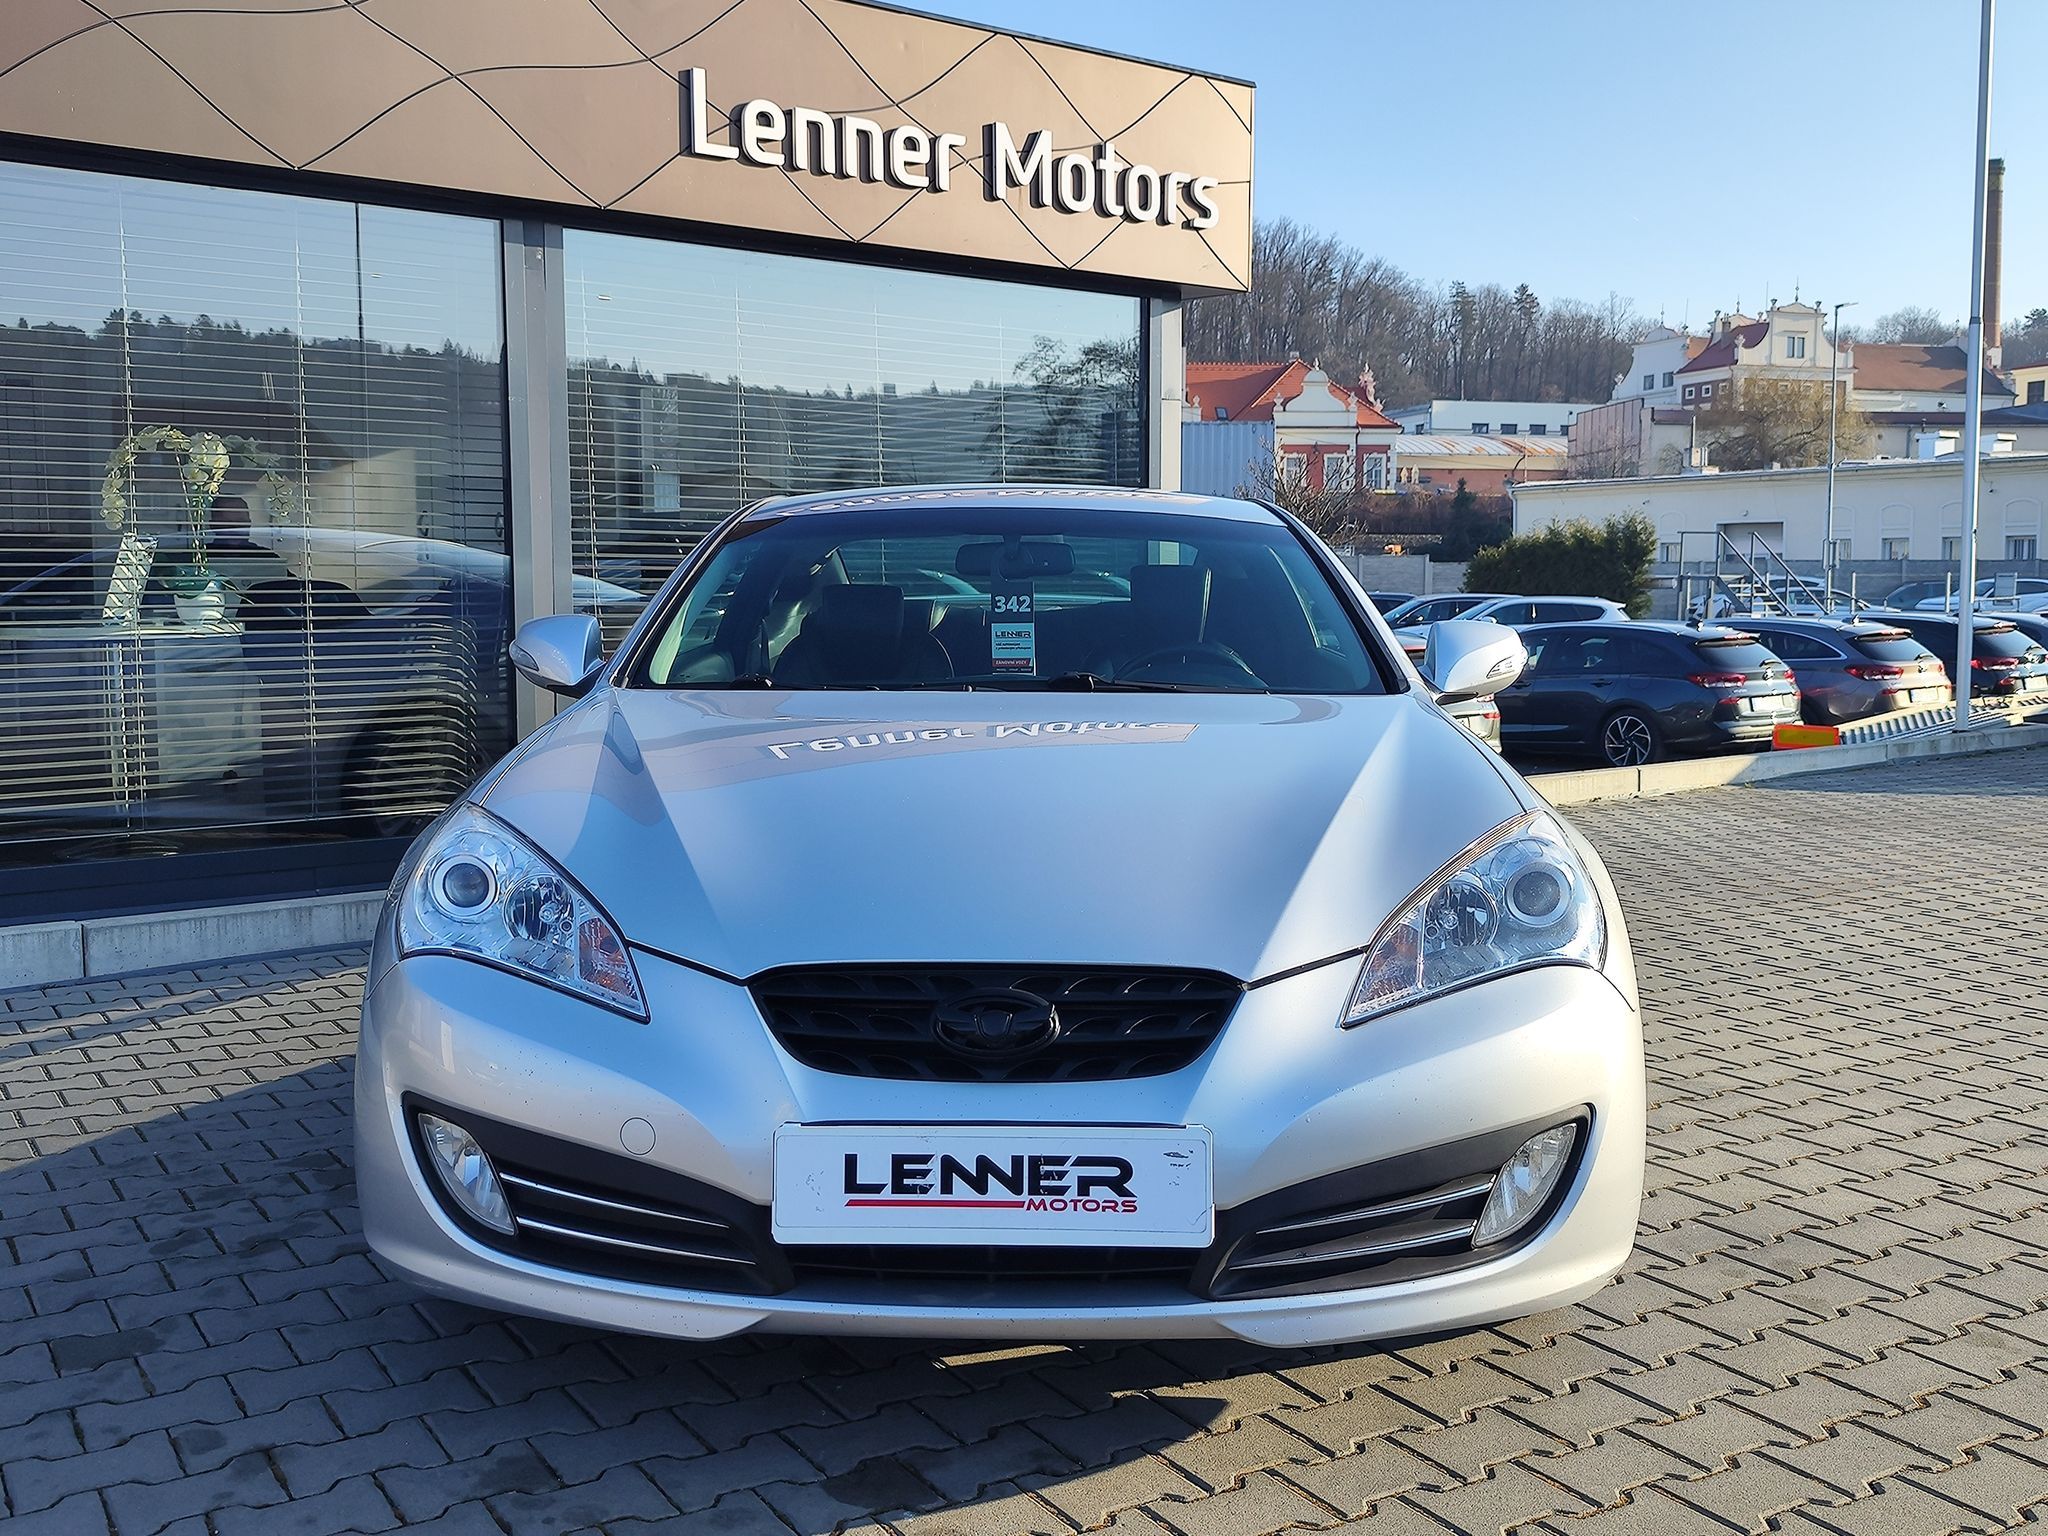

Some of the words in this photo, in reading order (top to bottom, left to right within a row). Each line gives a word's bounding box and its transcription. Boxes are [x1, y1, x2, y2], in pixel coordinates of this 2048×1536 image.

[685, 66, 967, 192] Lenner
[987, 121, 1220, 230] Motors
[994, 595, 1031, 613] 342
[995, 630, 1032, 639] LENNER
[843, 1153, 1138, 1197] LENNER
[1024, 1198, 1138, 1213] MOTORS
